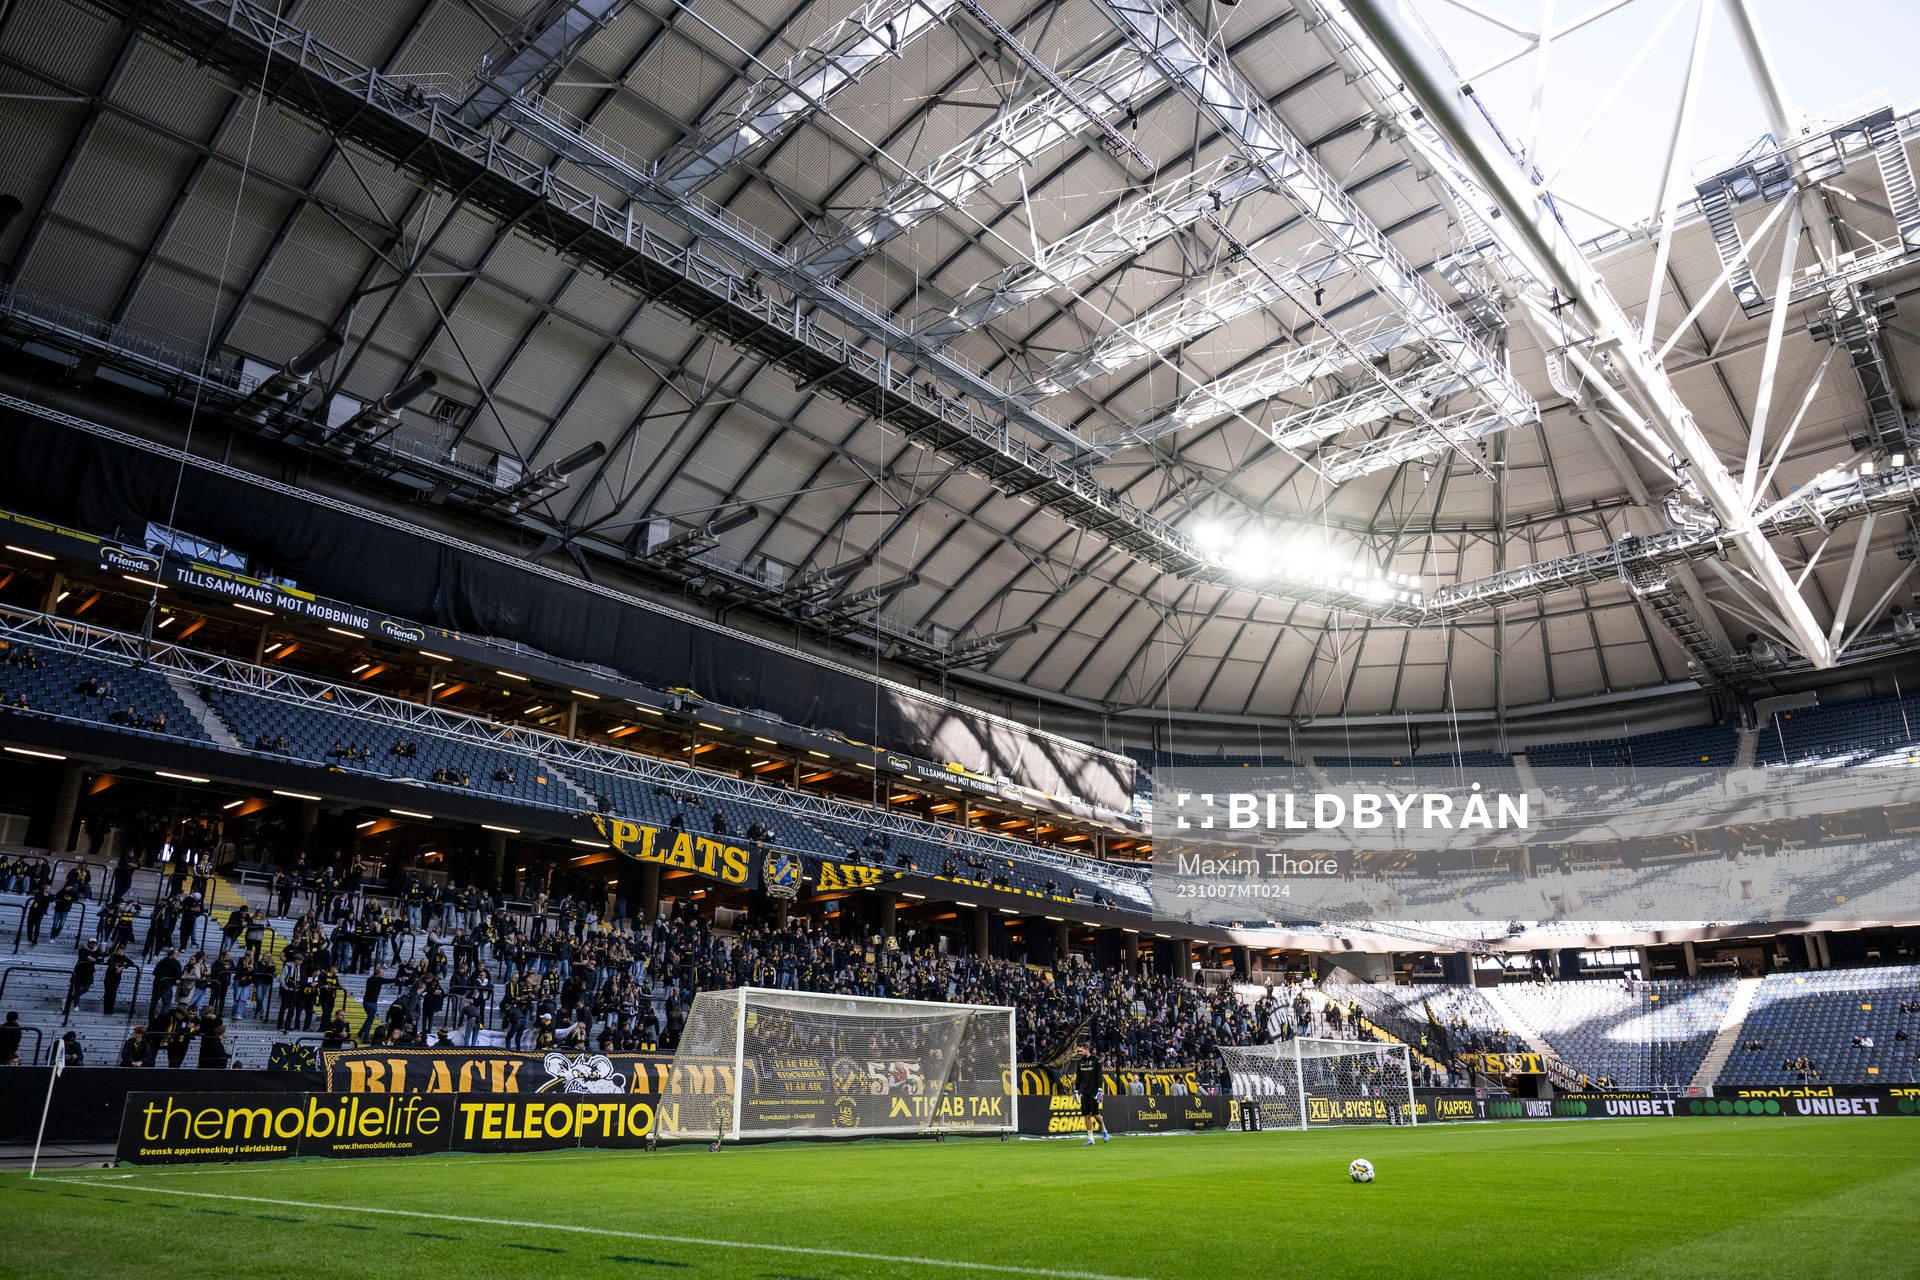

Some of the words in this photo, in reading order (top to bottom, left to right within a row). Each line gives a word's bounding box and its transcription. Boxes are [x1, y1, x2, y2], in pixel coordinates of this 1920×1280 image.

[108, 553, 150, 571] friends
[177, 568, 272, 604] TILLSAMMANS
[276, 595, 303, 612] MOT
[306, 604, 369, 629] MOBBNING
[386, 626, 417, 641] friends
[917, 766, 957, 783] TILLSAMMANS
[958, 776, 969, 786] MOT
[609, 819, 749, 884] PLATS
[345, 1059, 523, 1094] BLACK
[969, 1096, 1002, 1116] TAK
[1329, 1101, 1372, 1118] XL-BYGG
[1443, 1100, 1475, 1115] KAPPEX
[1526, 1100, 1551, 1117] UNIBET
[1605, 1100, 1676, 1116] UNIBET
[1796, 1098, 1879, 1115] UNIBET
[143, 1096, 441, 1141] themobilelife
[140, 1147, 173, 1156] Svensk
[240, 1144, 287, 1153] världsklass
[332, 1141, 413, 1150] www.themobilelife.com
